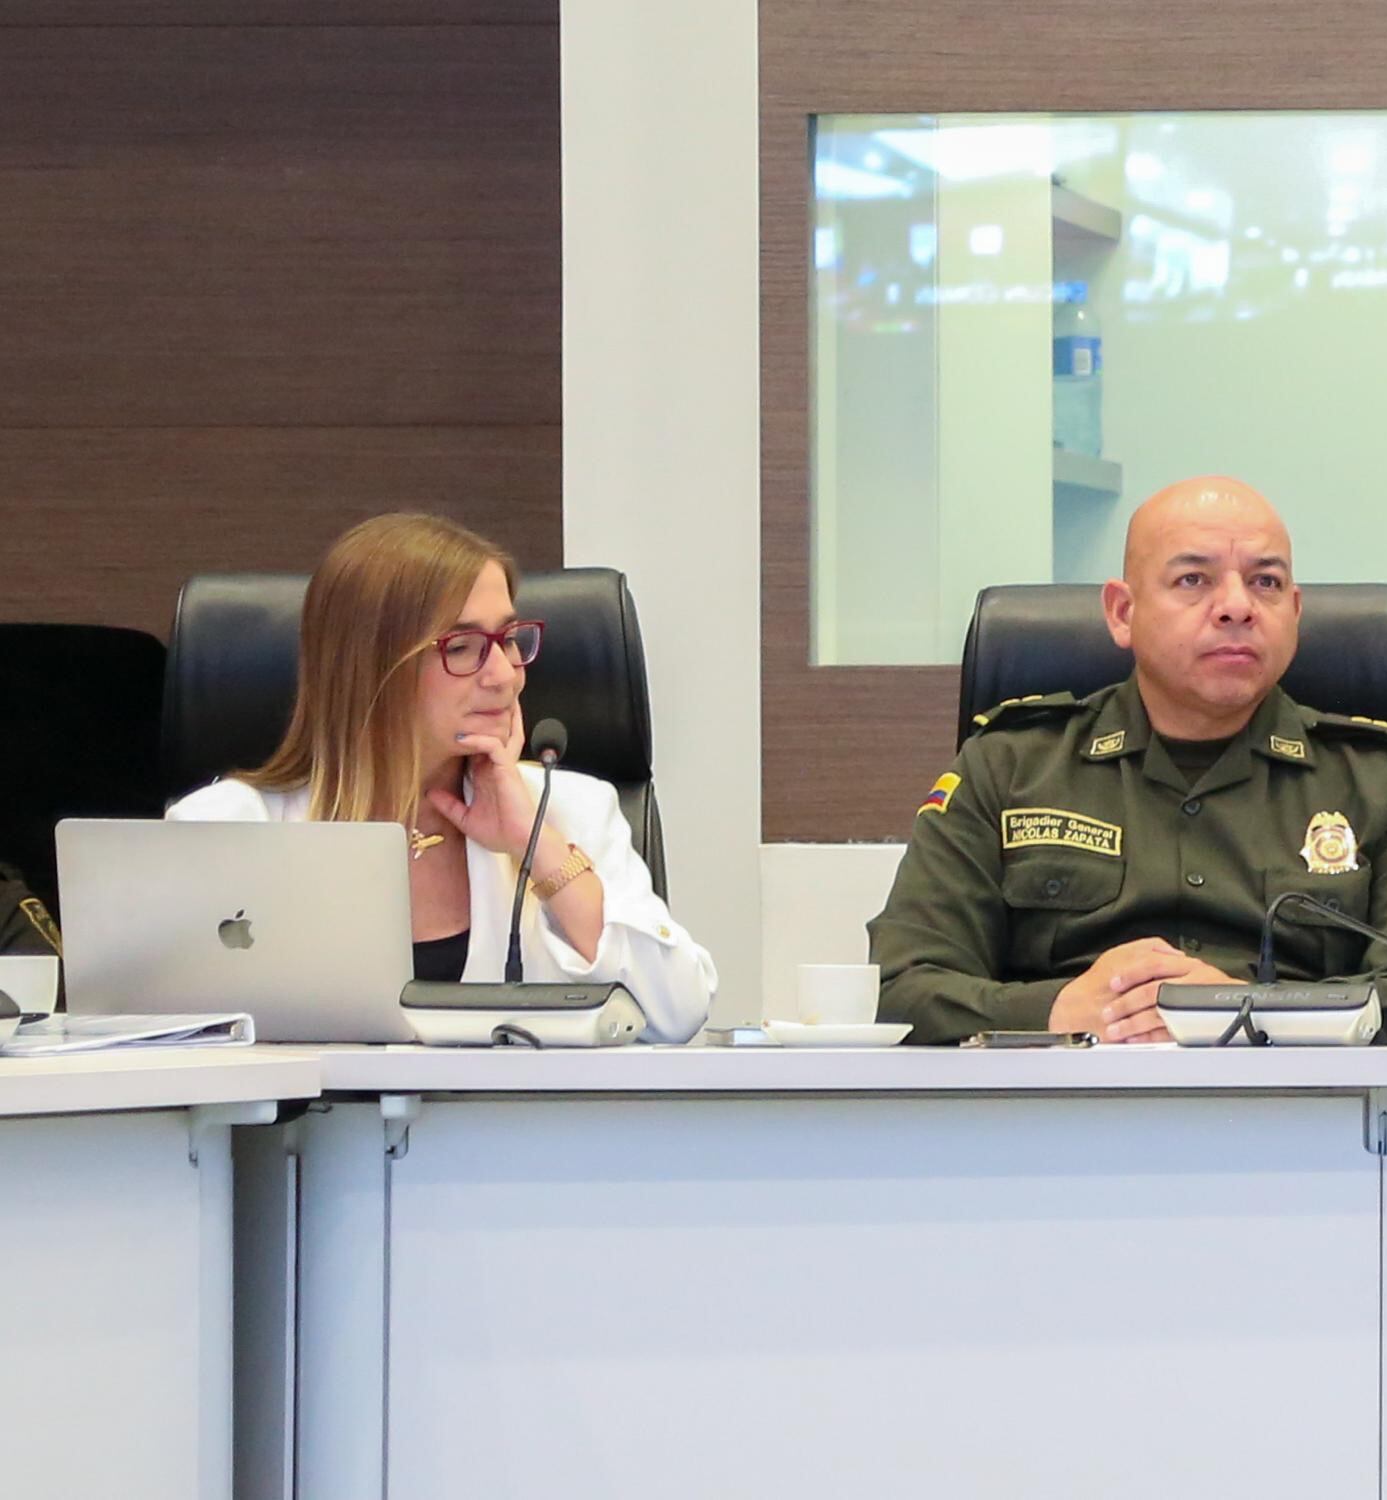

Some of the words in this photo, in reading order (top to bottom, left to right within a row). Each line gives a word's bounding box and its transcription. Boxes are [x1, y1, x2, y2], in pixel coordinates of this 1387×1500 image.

[1010, 815, 1062, 829] Brigadier
[1068, 820, 1113, 839] General
[1063, 830, 1111, 848] ZAPATA
